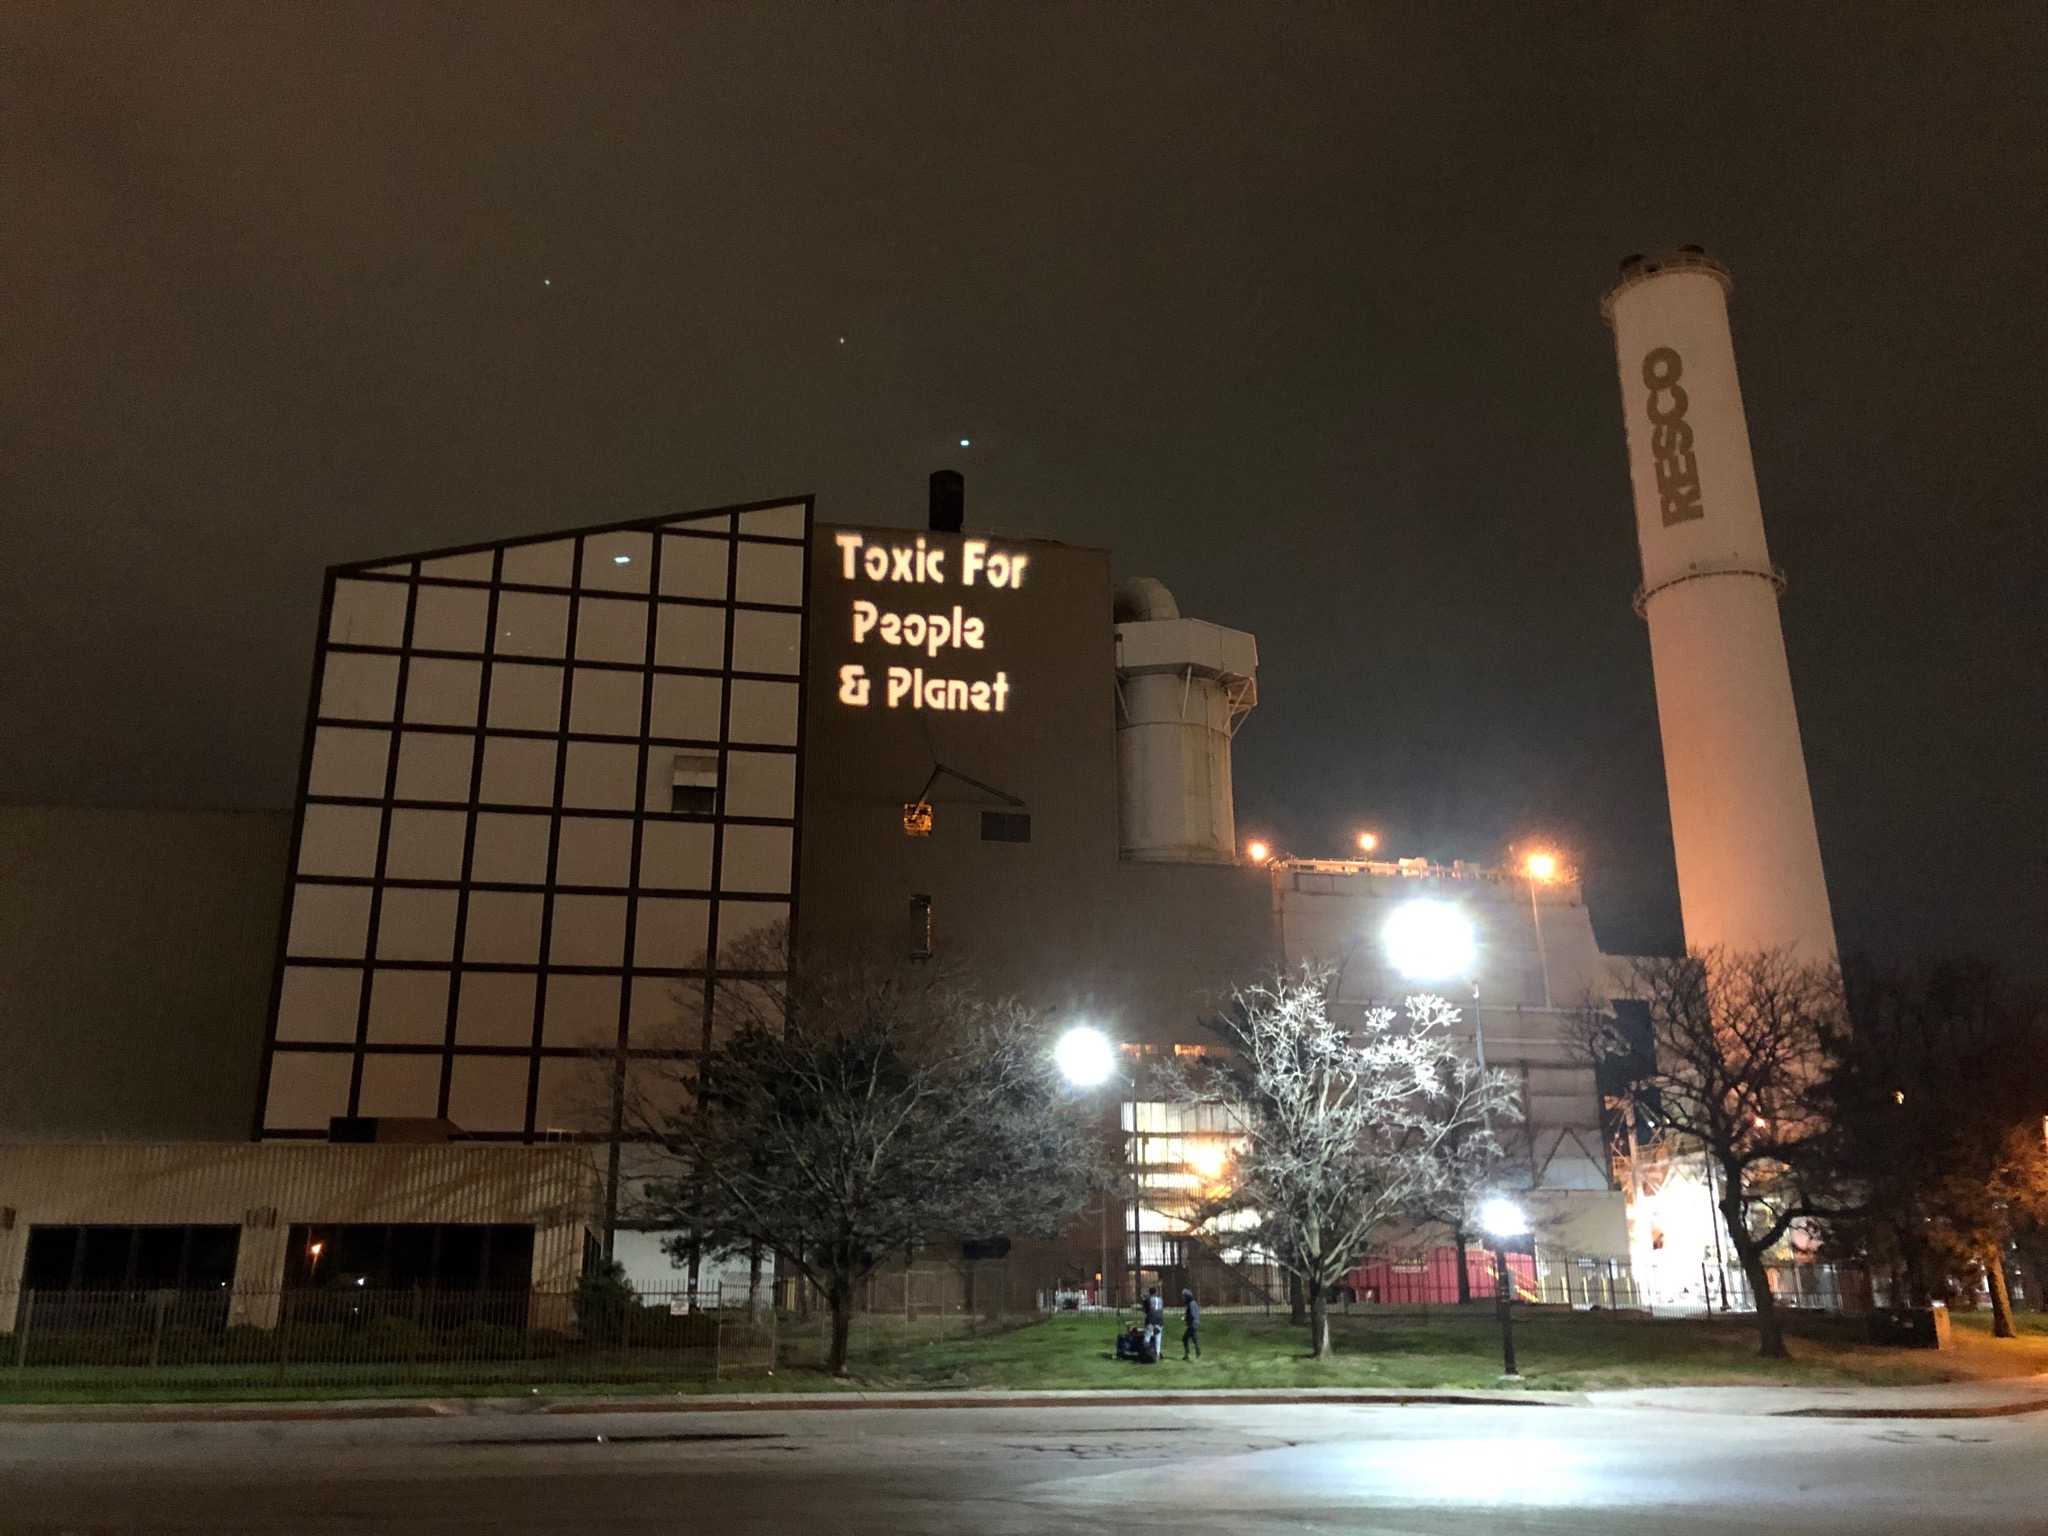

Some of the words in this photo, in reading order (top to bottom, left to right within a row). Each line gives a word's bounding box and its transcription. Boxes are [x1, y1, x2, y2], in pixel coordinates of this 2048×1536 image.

[1642, 347, 1704, 528] RESCO
[835, 533, 945, 583] Toxic
[961, 540, 1028, 589] For
[853, 600, 985, 657] People
[839, 664, 870, 706] &
[887, 666, 1008, 712] Planet
